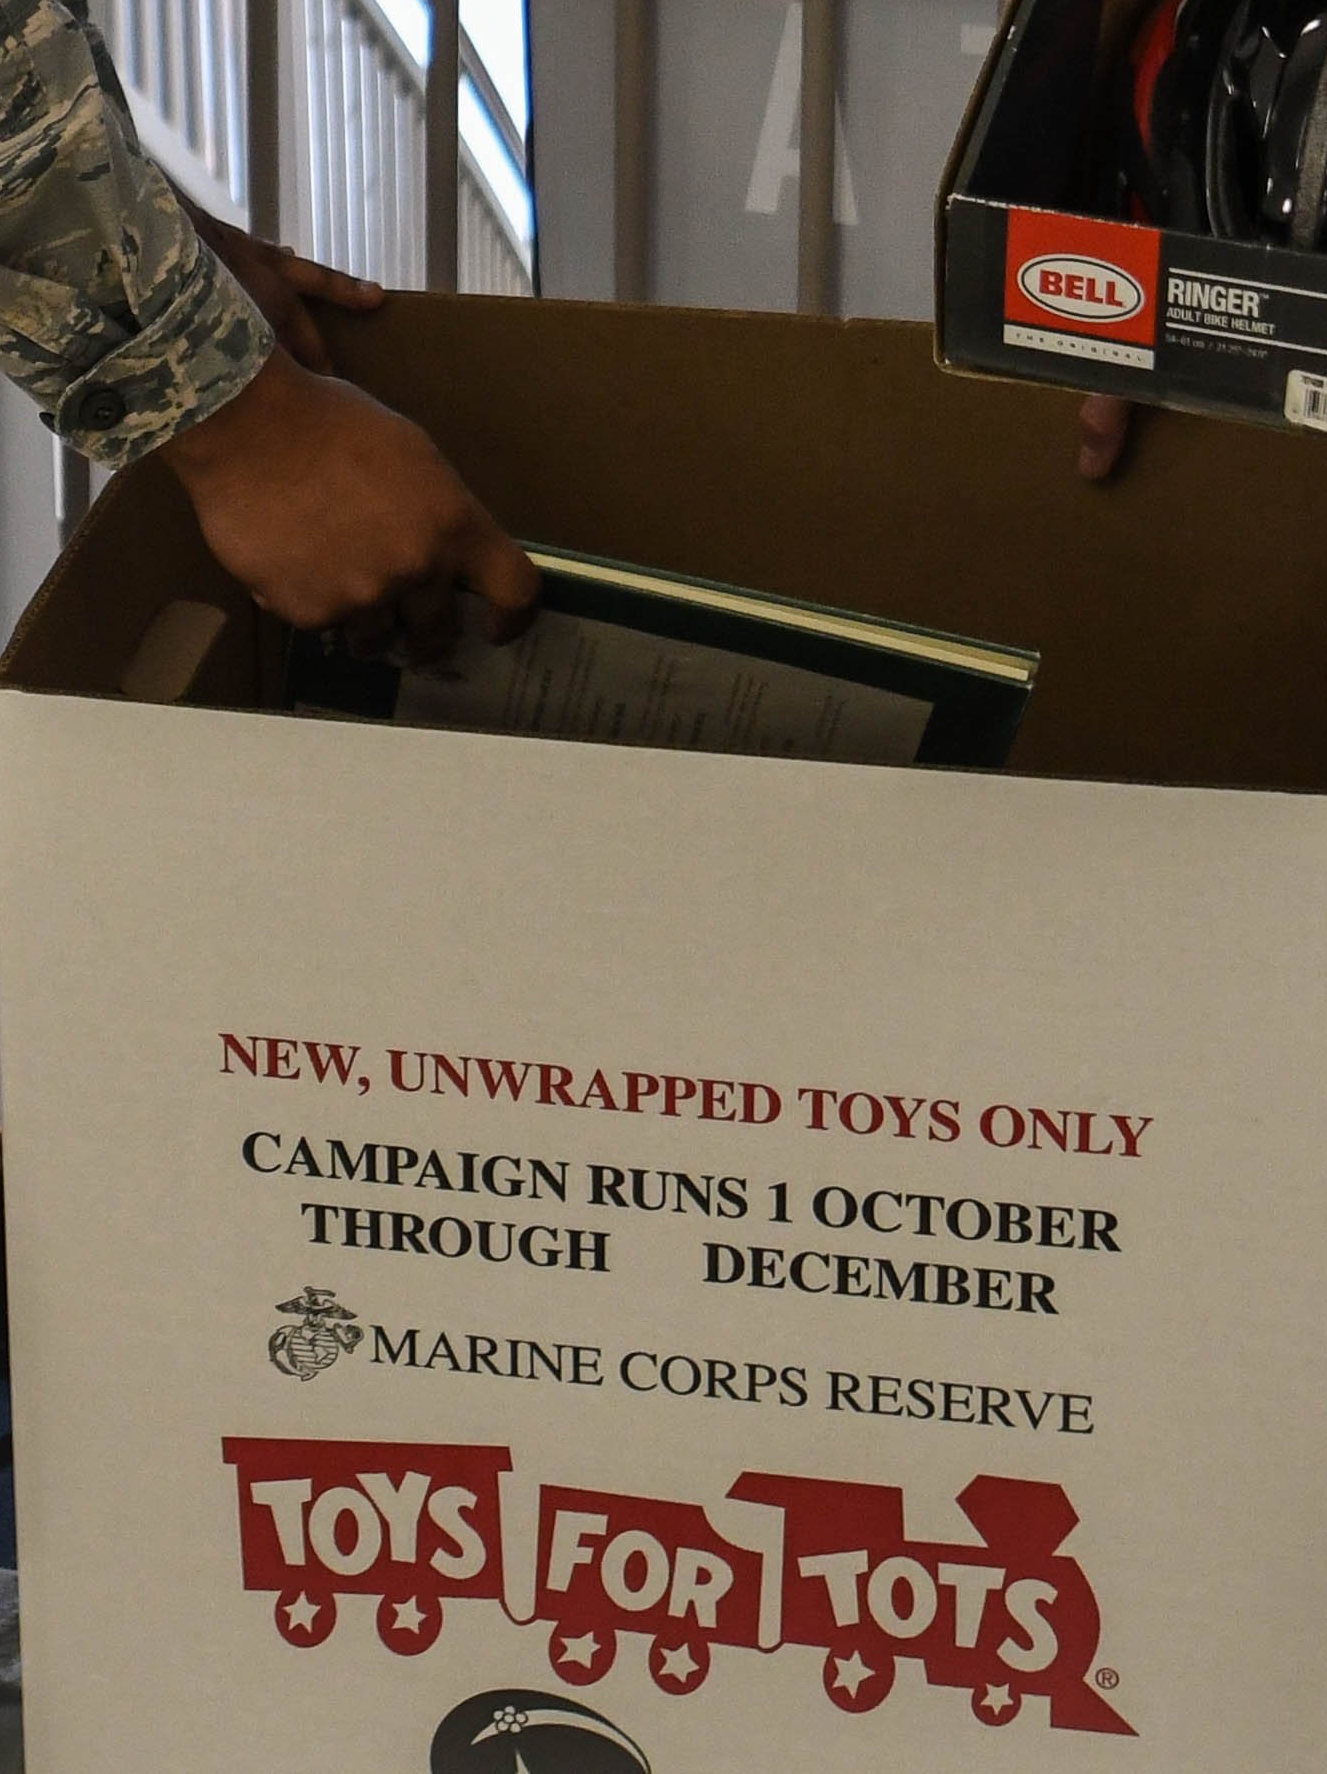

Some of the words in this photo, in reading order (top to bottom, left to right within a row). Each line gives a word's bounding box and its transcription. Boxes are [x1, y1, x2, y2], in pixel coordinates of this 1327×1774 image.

[1039, 270, 1125, 307] BELL
[1166, 306, 1202, 324] ADULT
[1204, 313, 1229, 328] BIKE
[1231, 317, 1275, 336] HELMET
[218, 1033, 372, 1095] NEW,
[386, 1049, 782, 1124] UNWRAPPED
[797, 1088, 962, 1142] TOYS
[978, 1104, 1154, 1157] ONLY
[242, 1131, 569, 1202] CAMPAIGN
[587, 1164, 749, 1220] RUNS
[768, 1181, 792, 1225] 1
[811, 1186, 1123, 1254] OCTOBER
[301, 1202, 612, 1273] THROUGH
[702, 1241, 1060, 1315] DECEMBER
[369, 1324, 604, 1388] MARINE
[619, 1352, 809, 1409] CORPS
[826, 1371, 1096, 1435] RESERVE
[250, 1470, 488, 1580] TOYS
[545, 1510, 734, 1629] FOR
[797, 1549, 1060, 1674] TOTS
